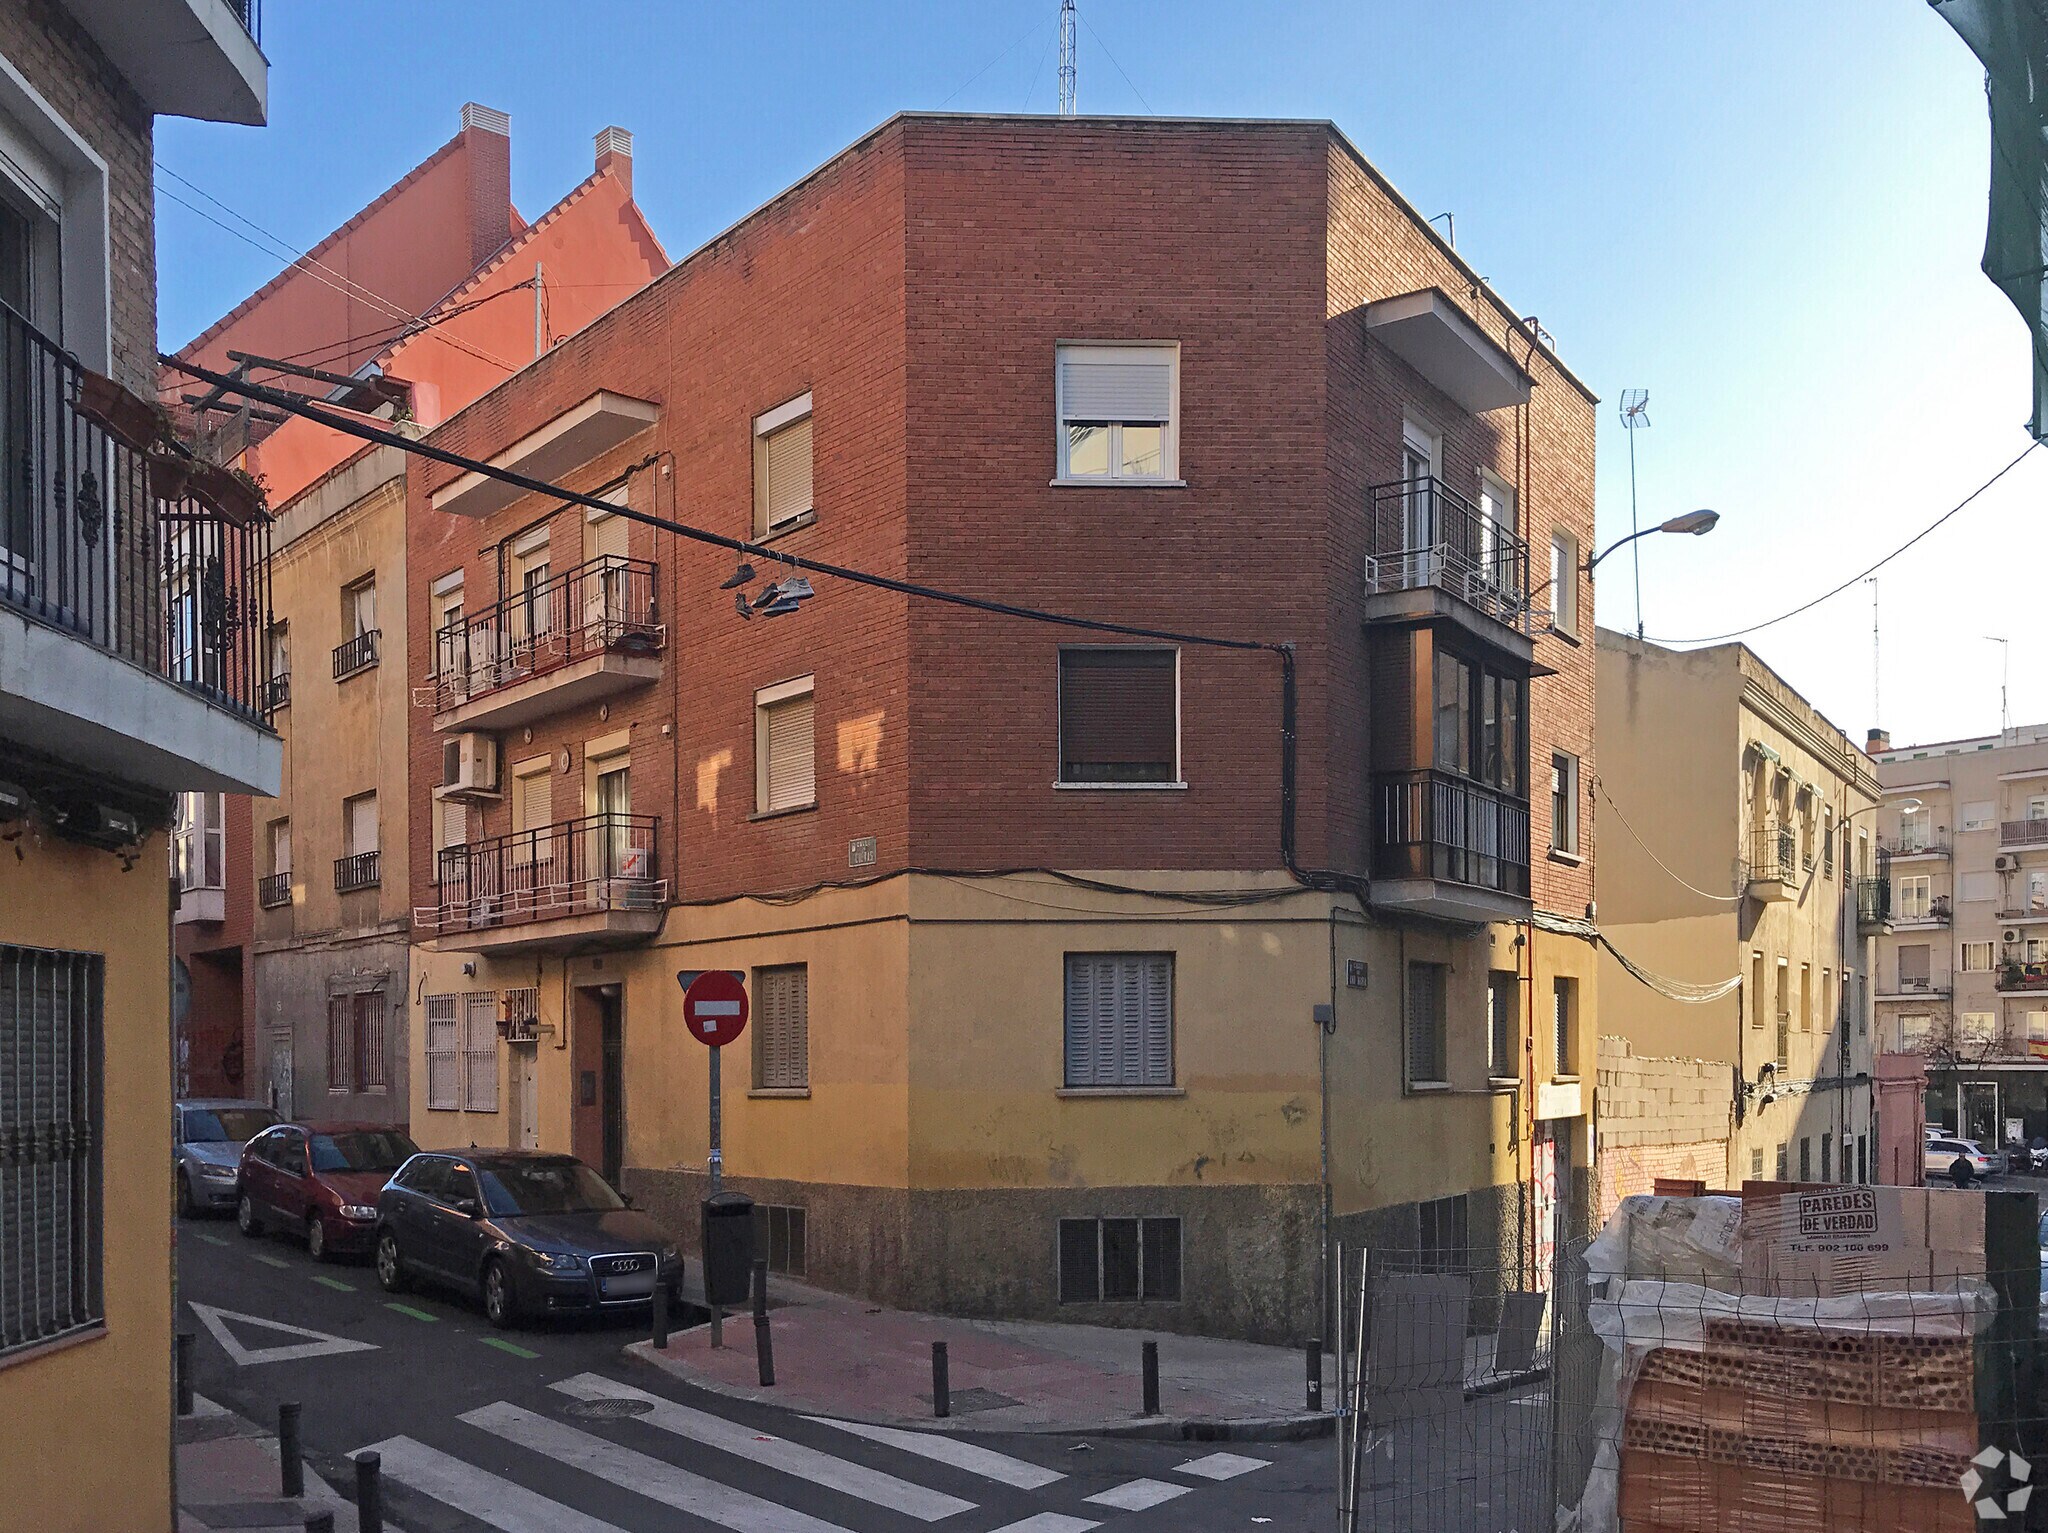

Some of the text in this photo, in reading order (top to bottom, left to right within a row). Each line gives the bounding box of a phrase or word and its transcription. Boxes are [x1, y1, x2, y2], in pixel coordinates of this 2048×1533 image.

[1802, 1192, 1873, 1213] PAREDES
[1803, 1214, 1874, 1231] DE VERDAD
[1818, 1243, 1840, 1252] 902
